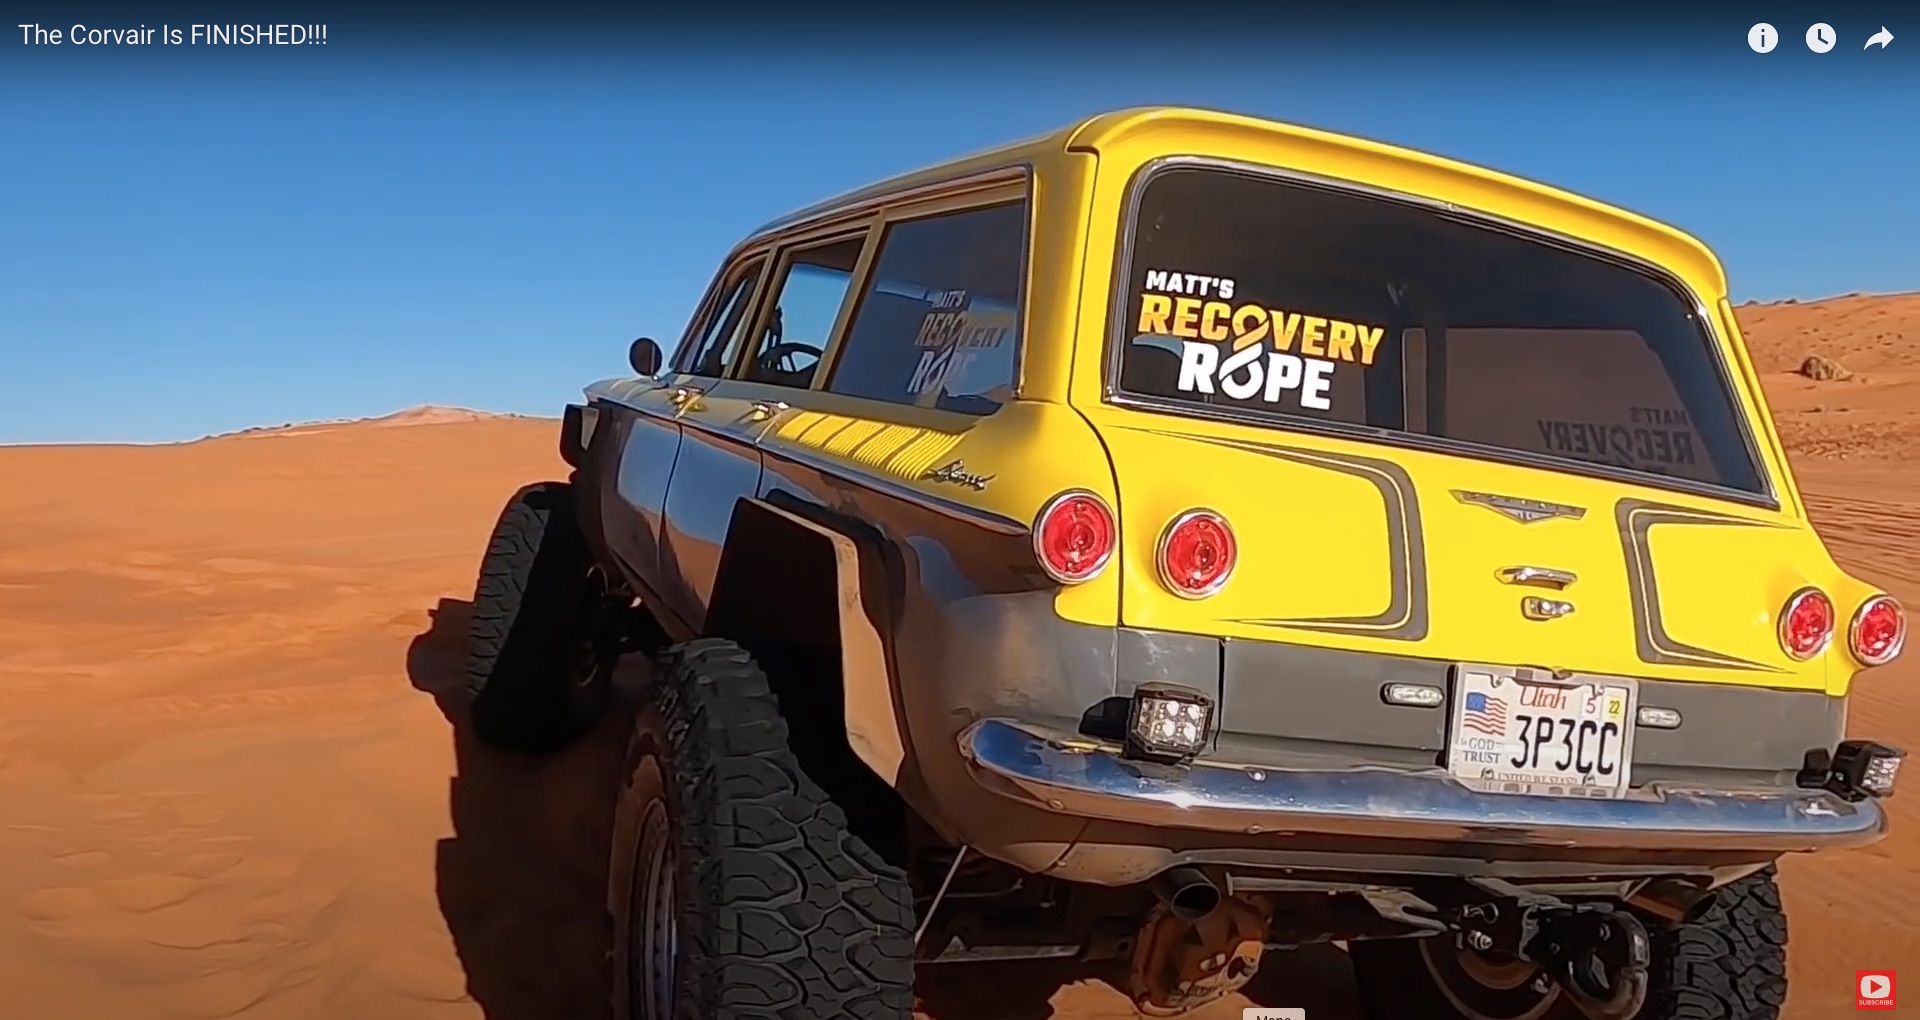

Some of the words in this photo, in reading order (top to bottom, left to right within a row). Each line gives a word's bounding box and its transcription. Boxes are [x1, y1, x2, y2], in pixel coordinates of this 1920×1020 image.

[1145, 270, 1236, 299] MATT'S
[1137, 293, 1385, 365] RECOVERY
[1177, 341, 1335, 411] ROPE
[1519, 685, 1568, 710] Utah
[1585, 697, 1596, 714] 5
[1608, 700, 1621, 714] 22
[1468, 737, 1496, 750] GOD
[1510, 714, 1619, 775] 3P3CC
[1462, 750, 1502, 764] TRUST
